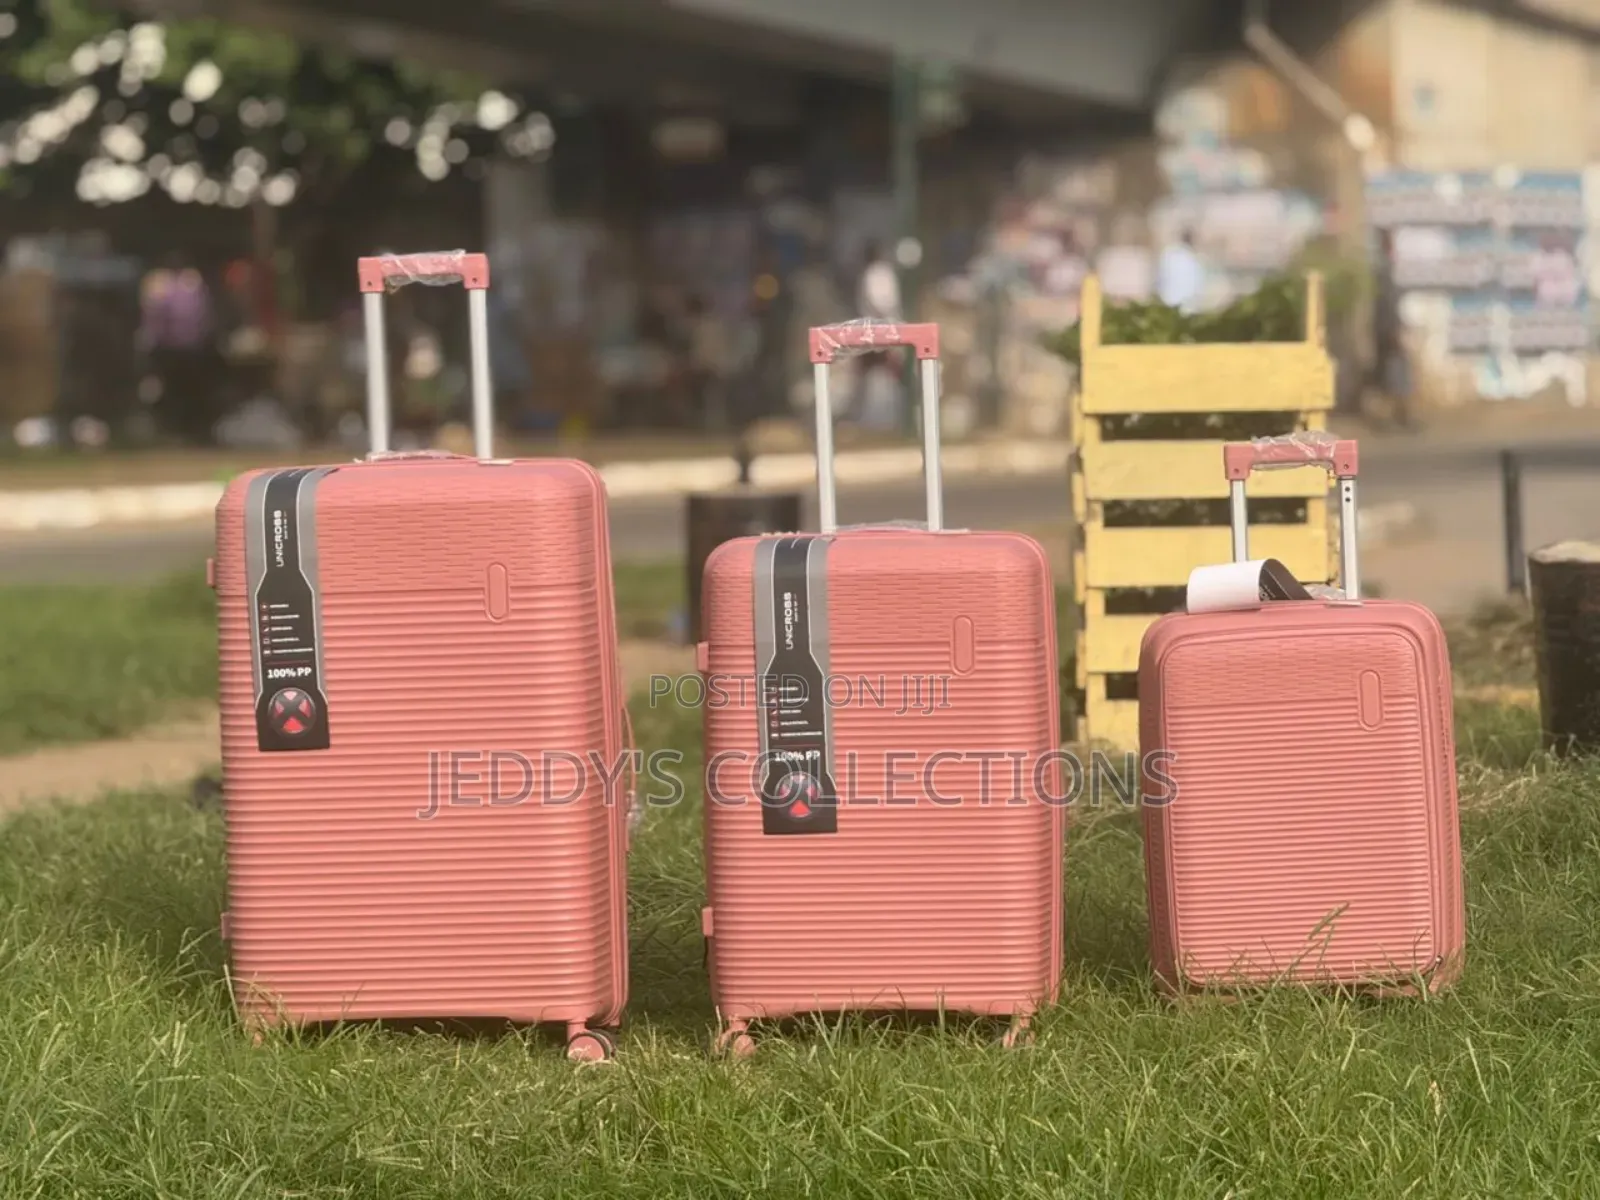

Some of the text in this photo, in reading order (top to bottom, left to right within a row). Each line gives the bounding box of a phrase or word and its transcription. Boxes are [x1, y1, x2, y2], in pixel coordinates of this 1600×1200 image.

[273, 509, 285, 568] UNICROSS
[783, 592, 794, 650] UNICROSS
[267, 666, 312, 679] 100% PP
